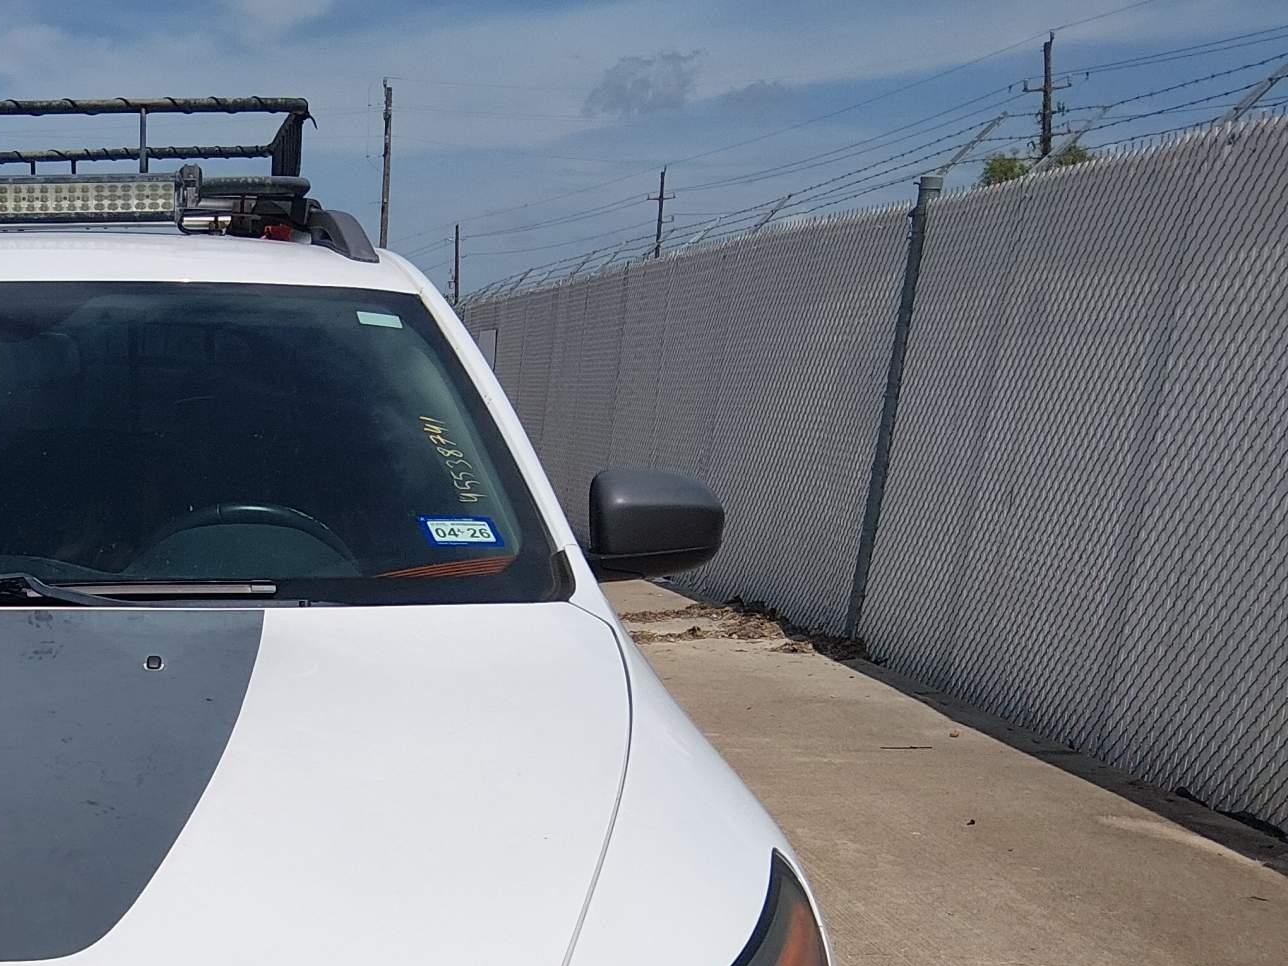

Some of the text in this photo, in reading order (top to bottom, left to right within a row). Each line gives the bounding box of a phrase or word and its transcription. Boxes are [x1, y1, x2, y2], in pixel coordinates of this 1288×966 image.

[419, 415, 488, 503] 45538741
[435, 528, 491, 539] 04 26
